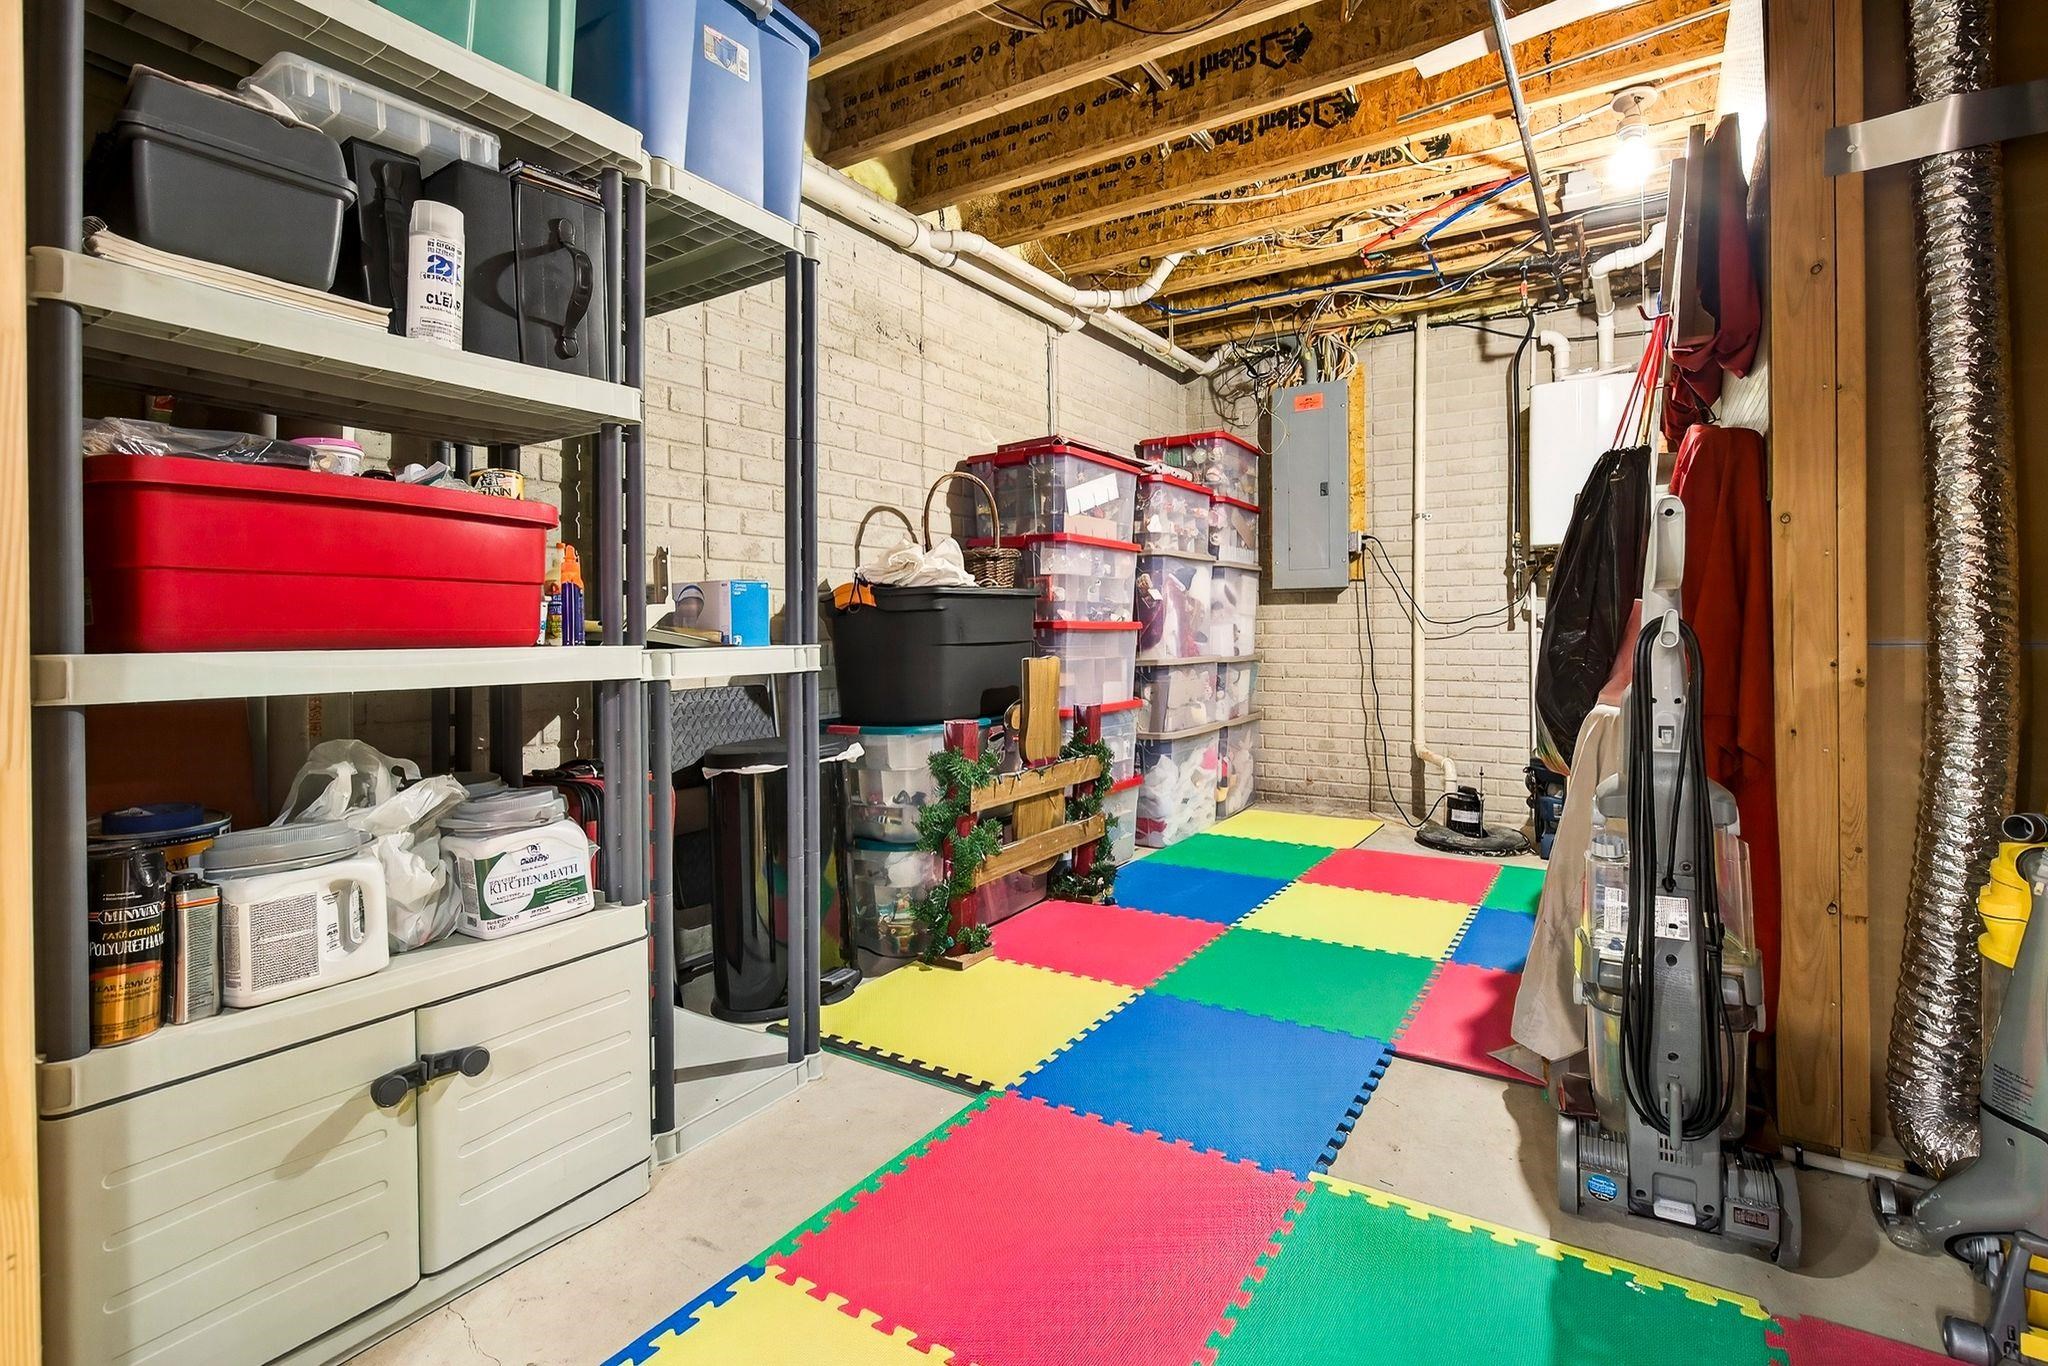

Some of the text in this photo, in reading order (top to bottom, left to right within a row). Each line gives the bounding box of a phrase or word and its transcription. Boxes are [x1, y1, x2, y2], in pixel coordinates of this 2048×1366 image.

[1199, 39, 1256, 81] Silent
[1208, 119, 1253, 147] Floo
[1258, 102, 1311, 137] Silent
[489, 873, 541, 895] KITCHEN
